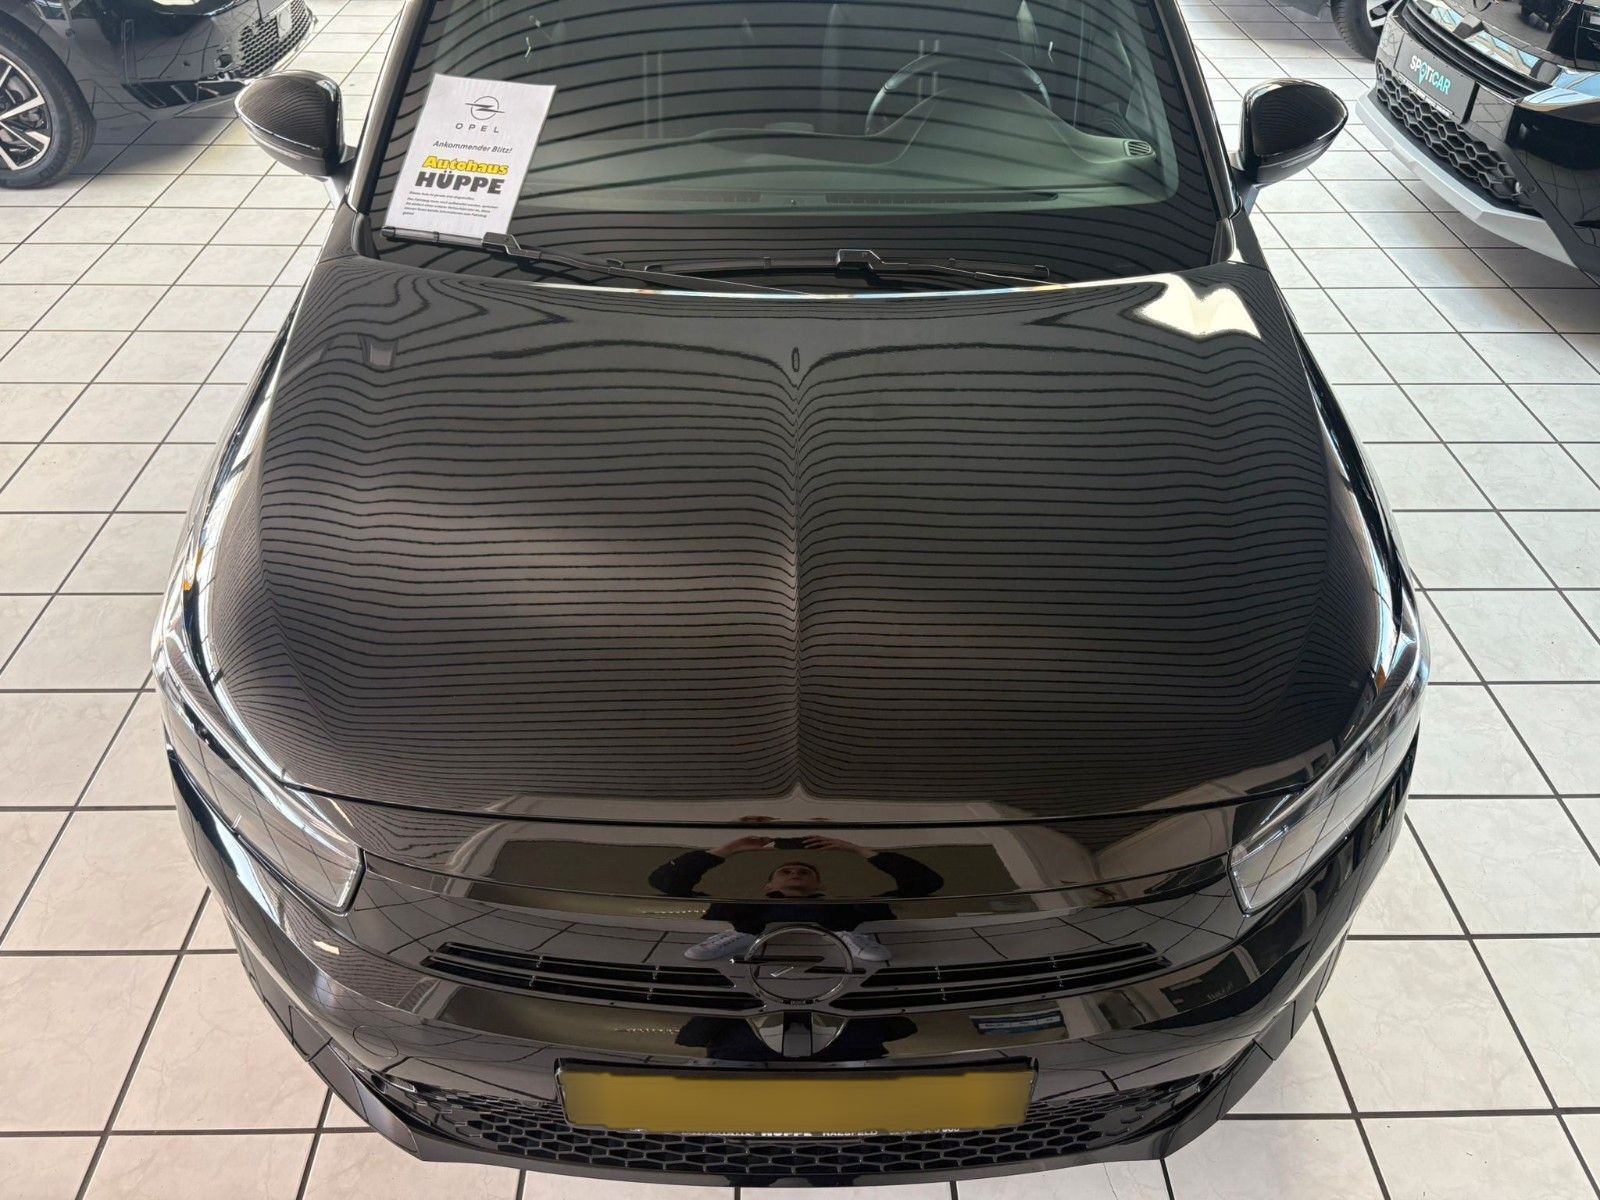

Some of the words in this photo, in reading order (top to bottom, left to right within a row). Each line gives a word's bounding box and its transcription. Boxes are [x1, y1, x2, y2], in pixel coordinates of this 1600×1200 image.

[455, 122, 499, 133] OPEL
[433, 140, 490, 152] Ankommender
[491, 145, 513, 154] Blitz!
[422, 155, 509, 175] Autohaus
[415, 170, 505, 194] HÜPPE
